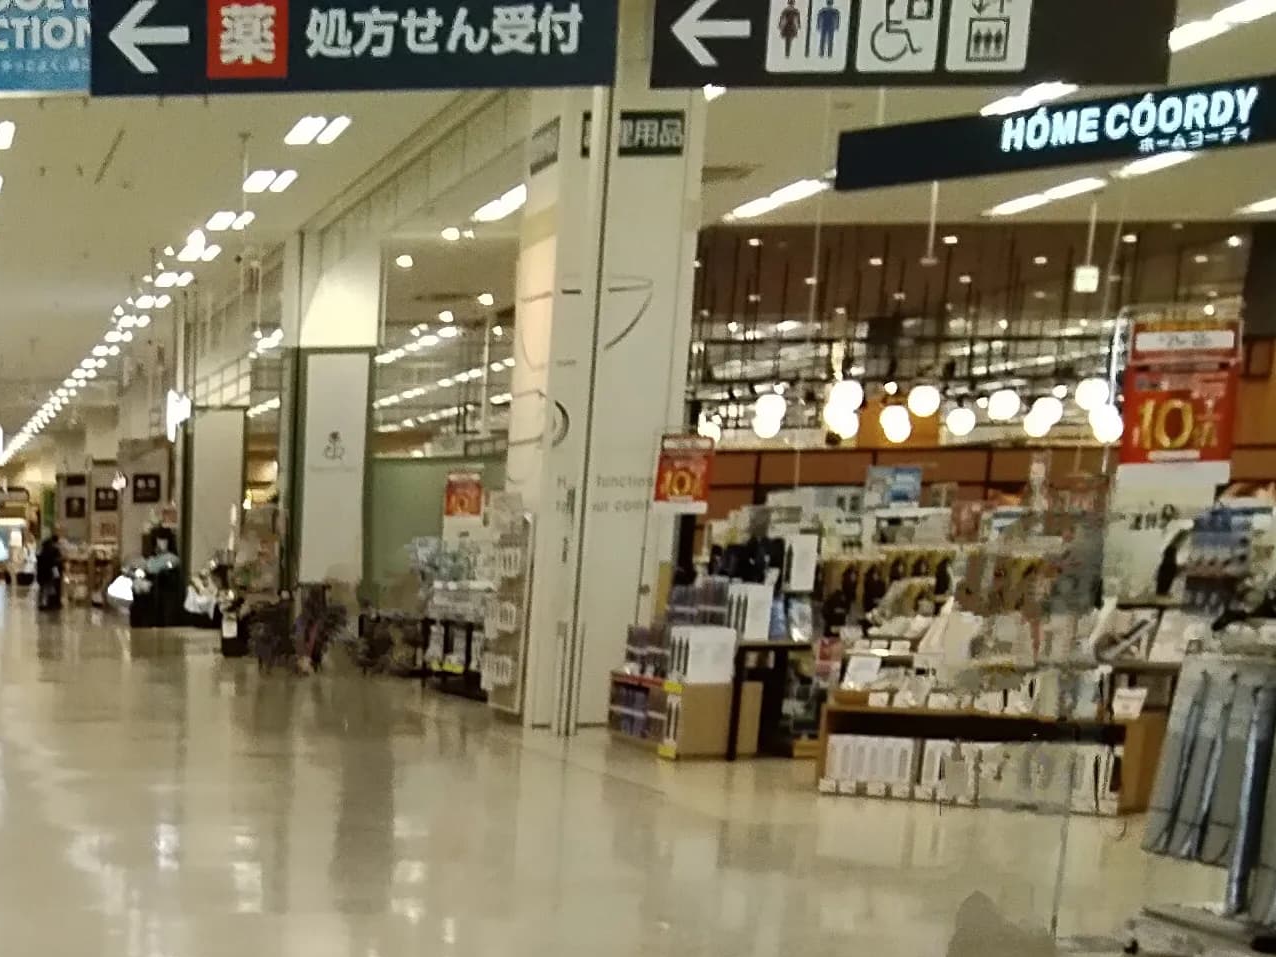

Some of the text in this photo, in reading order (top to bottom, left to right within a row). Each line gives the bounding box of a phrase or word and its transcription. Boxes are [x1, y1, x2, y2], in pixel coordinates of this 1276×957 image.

[220, 3, 584, 64] 薬 処方せん受付
